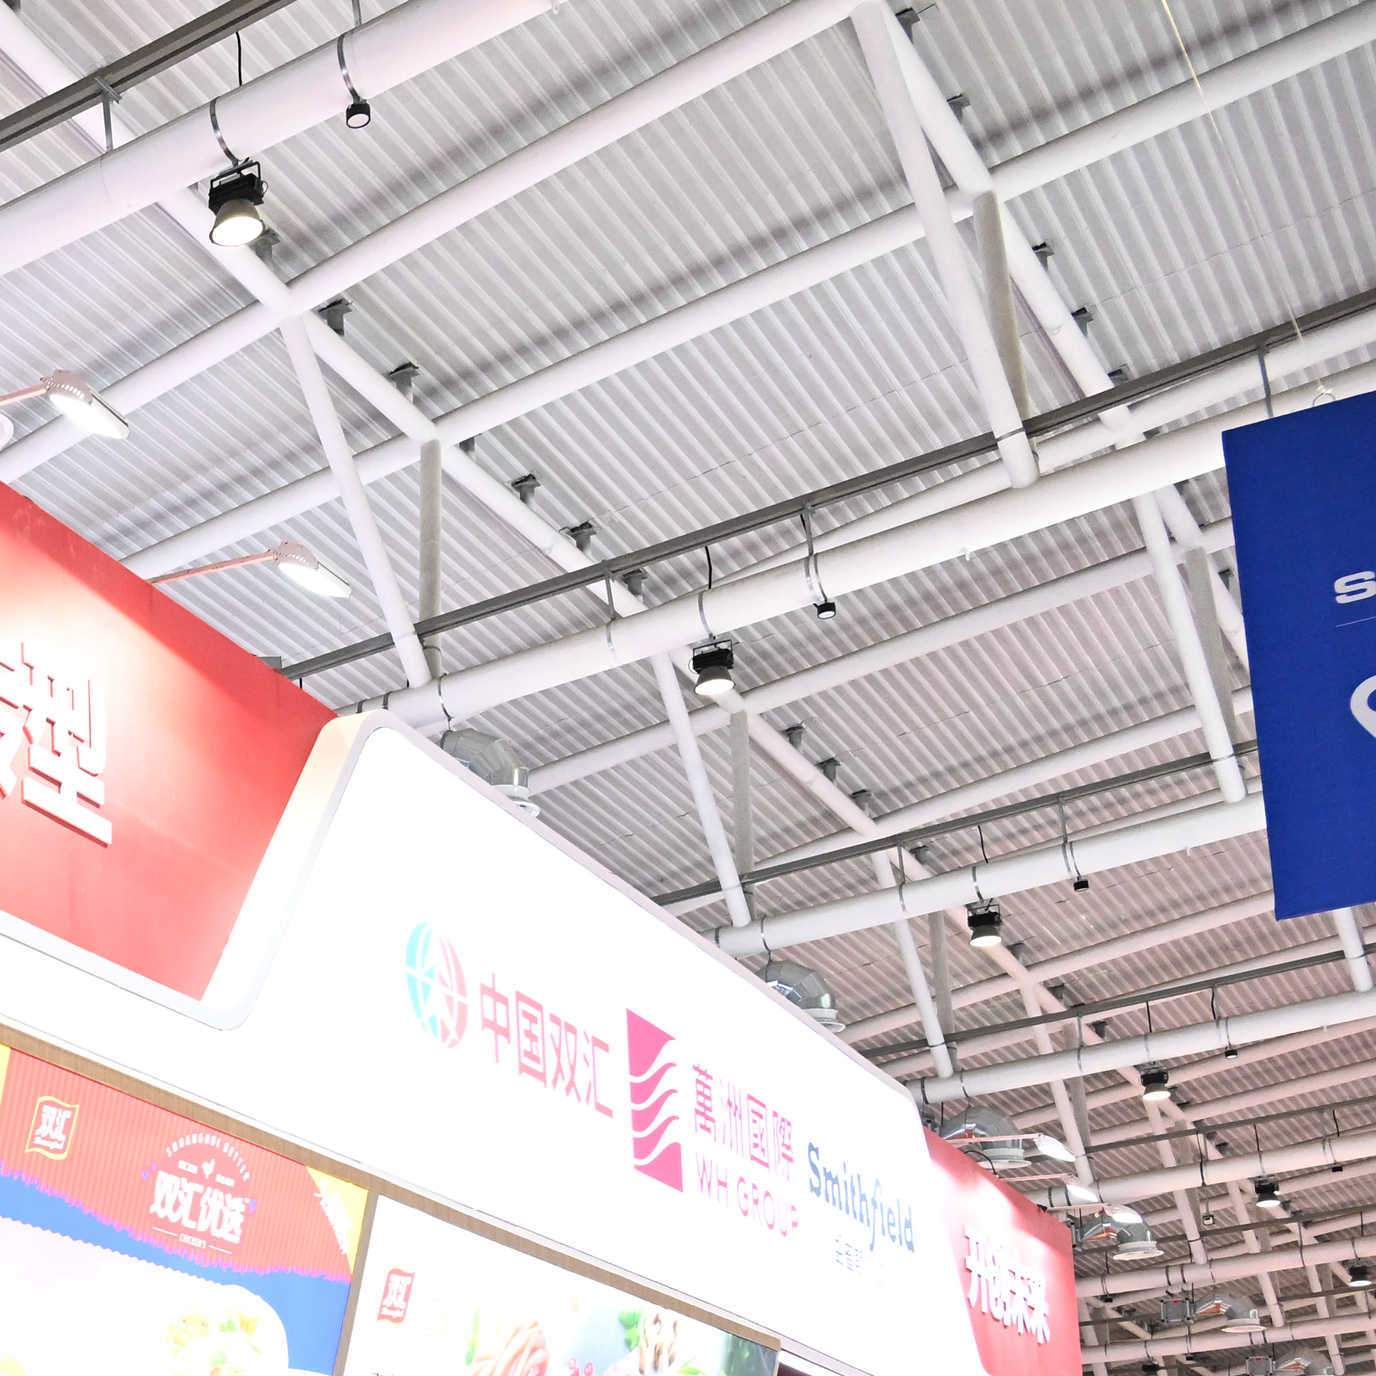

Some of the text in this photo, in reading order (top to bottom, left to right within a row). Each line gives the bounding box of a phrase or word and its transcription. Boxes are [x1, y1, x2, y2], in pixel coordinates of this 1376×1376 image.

[478, 972, 614, 1120] 中国双汇
[692, 1062, 795, 1182] 萬洲國際
[150, 1170, 247, 1244] 双汇优选
[695, 1149, 799, 1239] WH GROUP
[807, 1141, 915, 1253] Smithfield
[962, 1224, 1051, 1346] 开创未来
